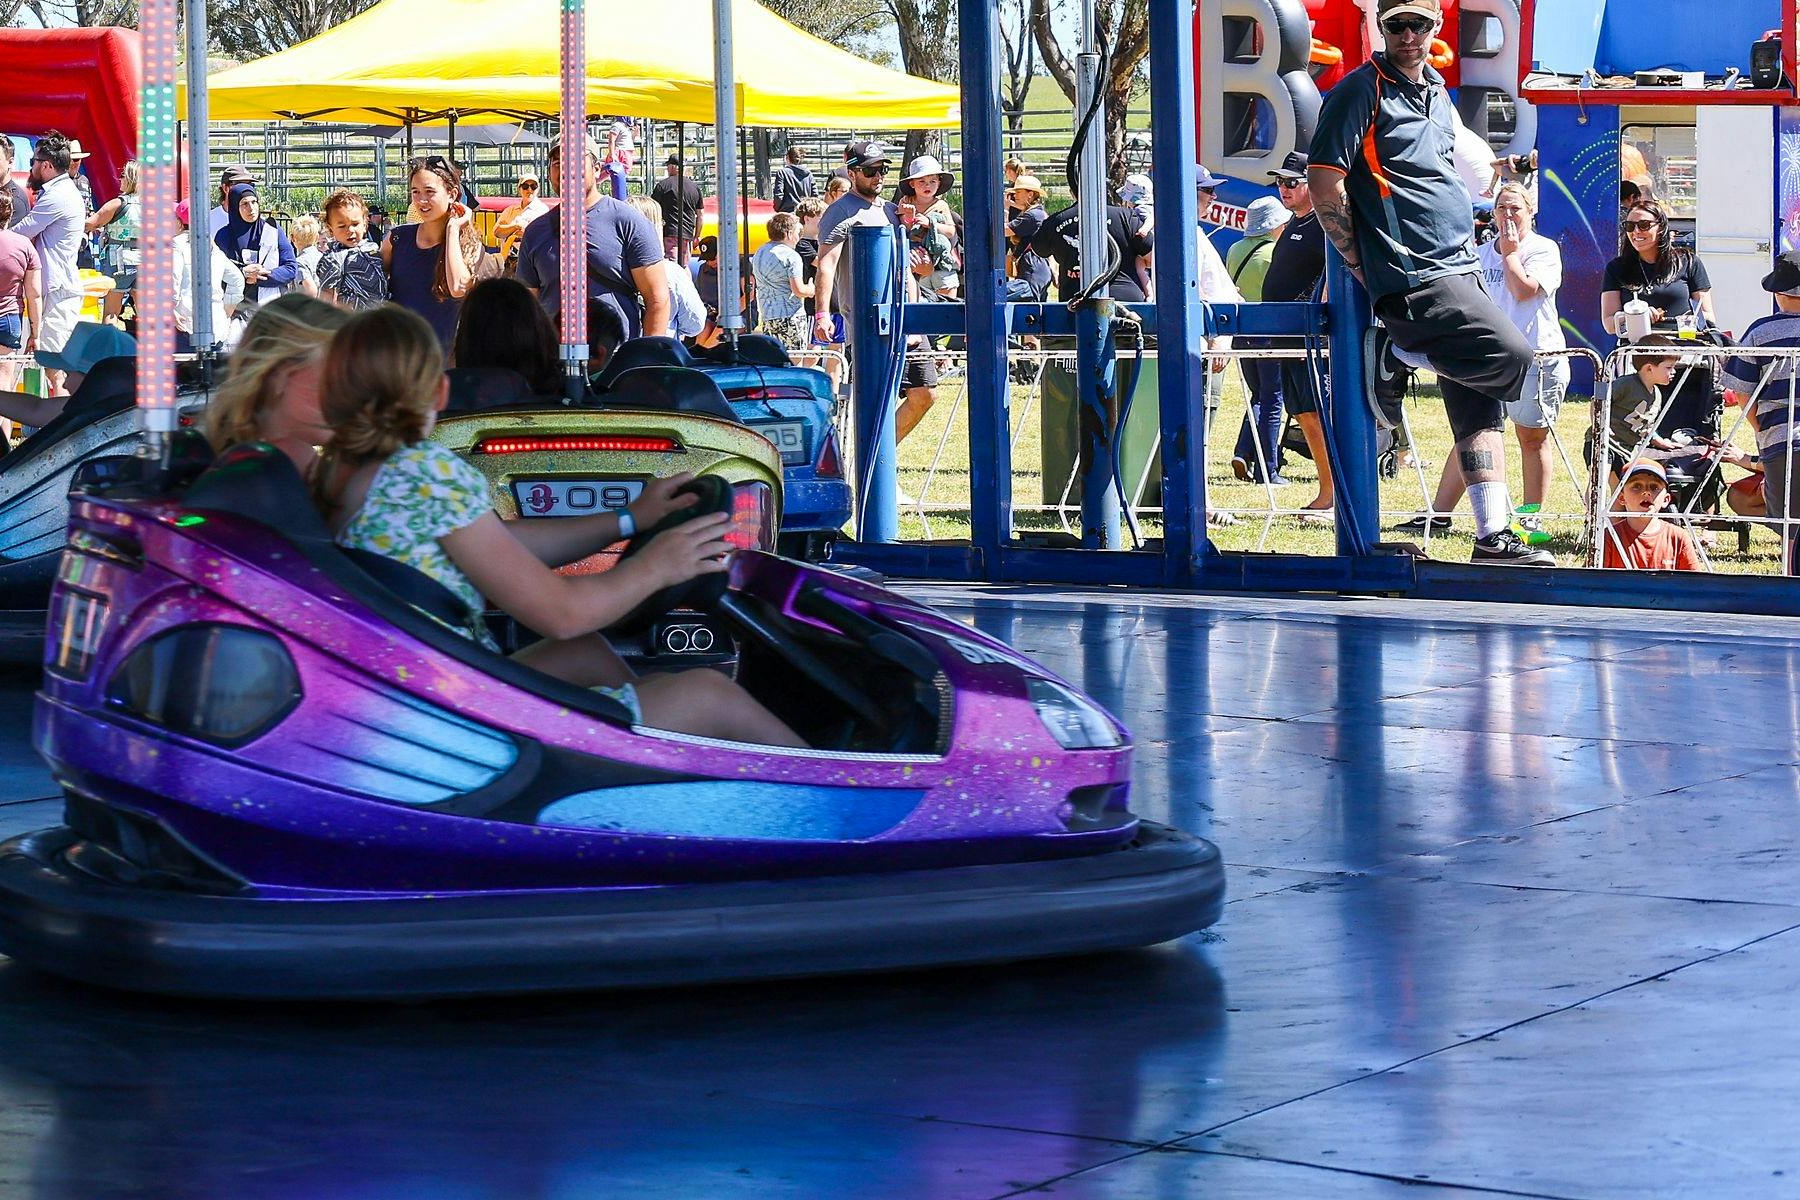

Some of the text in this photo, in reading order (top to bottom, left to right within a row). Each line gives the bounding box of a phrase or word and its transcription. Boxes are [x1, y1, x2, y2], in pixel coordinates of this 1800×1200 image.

[1201, 203, 1247, 229] OUR
[763, 427, 797, 446] 05
[566, 486, 631, 510] 09
